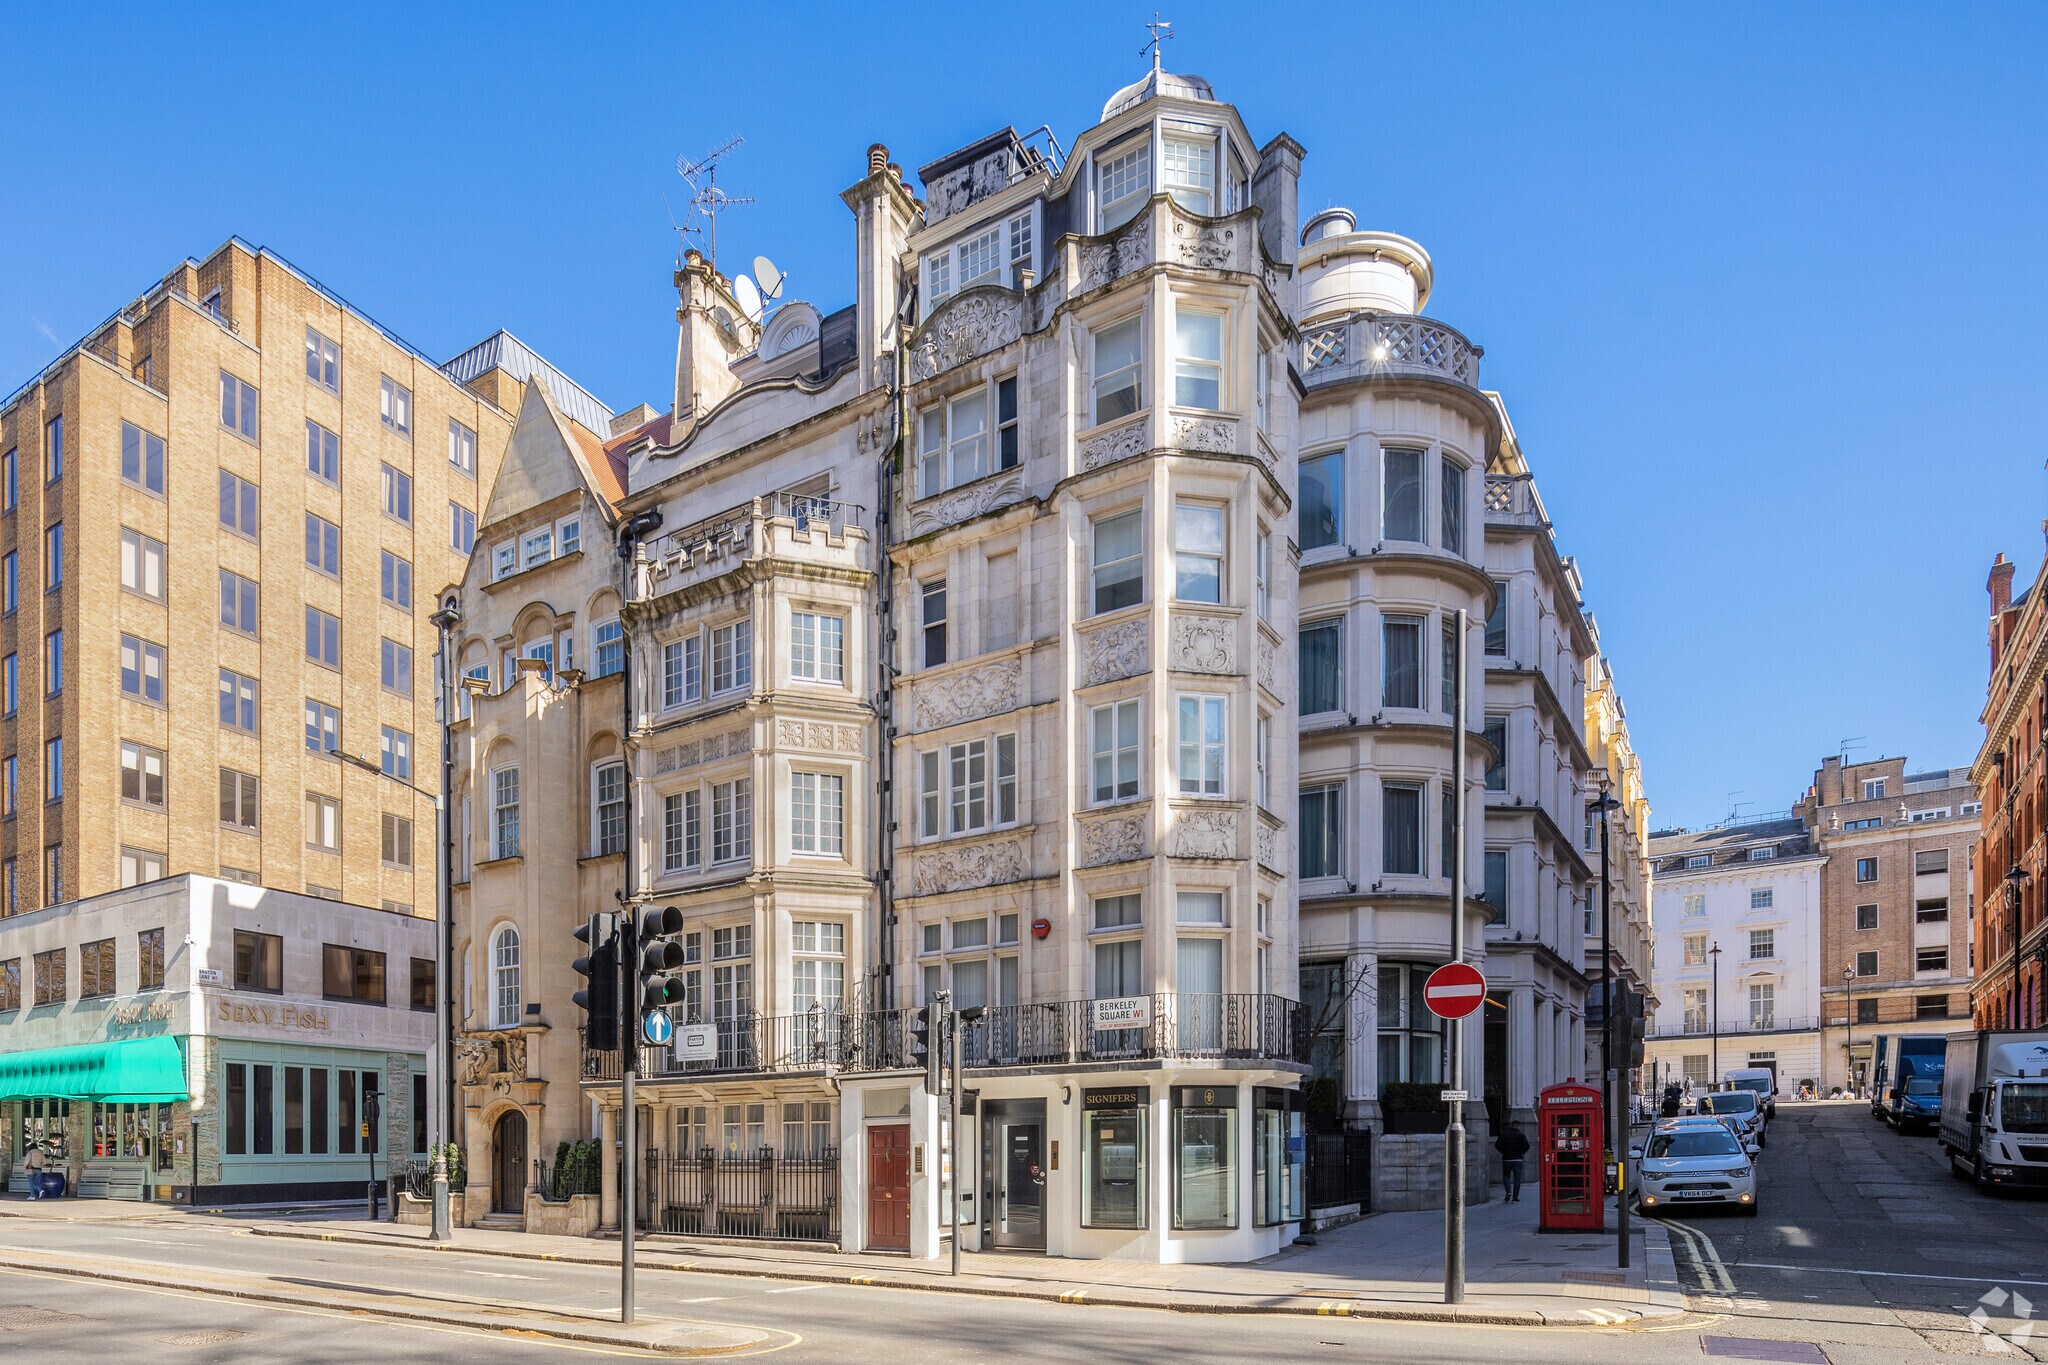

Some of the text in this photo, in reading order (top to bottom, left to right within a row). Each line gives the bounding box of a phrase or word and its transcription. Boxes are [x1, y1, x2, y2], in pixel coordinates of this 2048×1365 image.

[148, 1002, 175, 1022] FISH
[1100, 1001, 1137, 1011] BERKELEY
[219, 1002, 329, 1030] SEXY FISH
[1100, 1010, 1144, 1020] SQUARE W1
[505, 1080, 511, 1095] 3
[1086, 1093, 1136, 1103] SIGNIFERS
